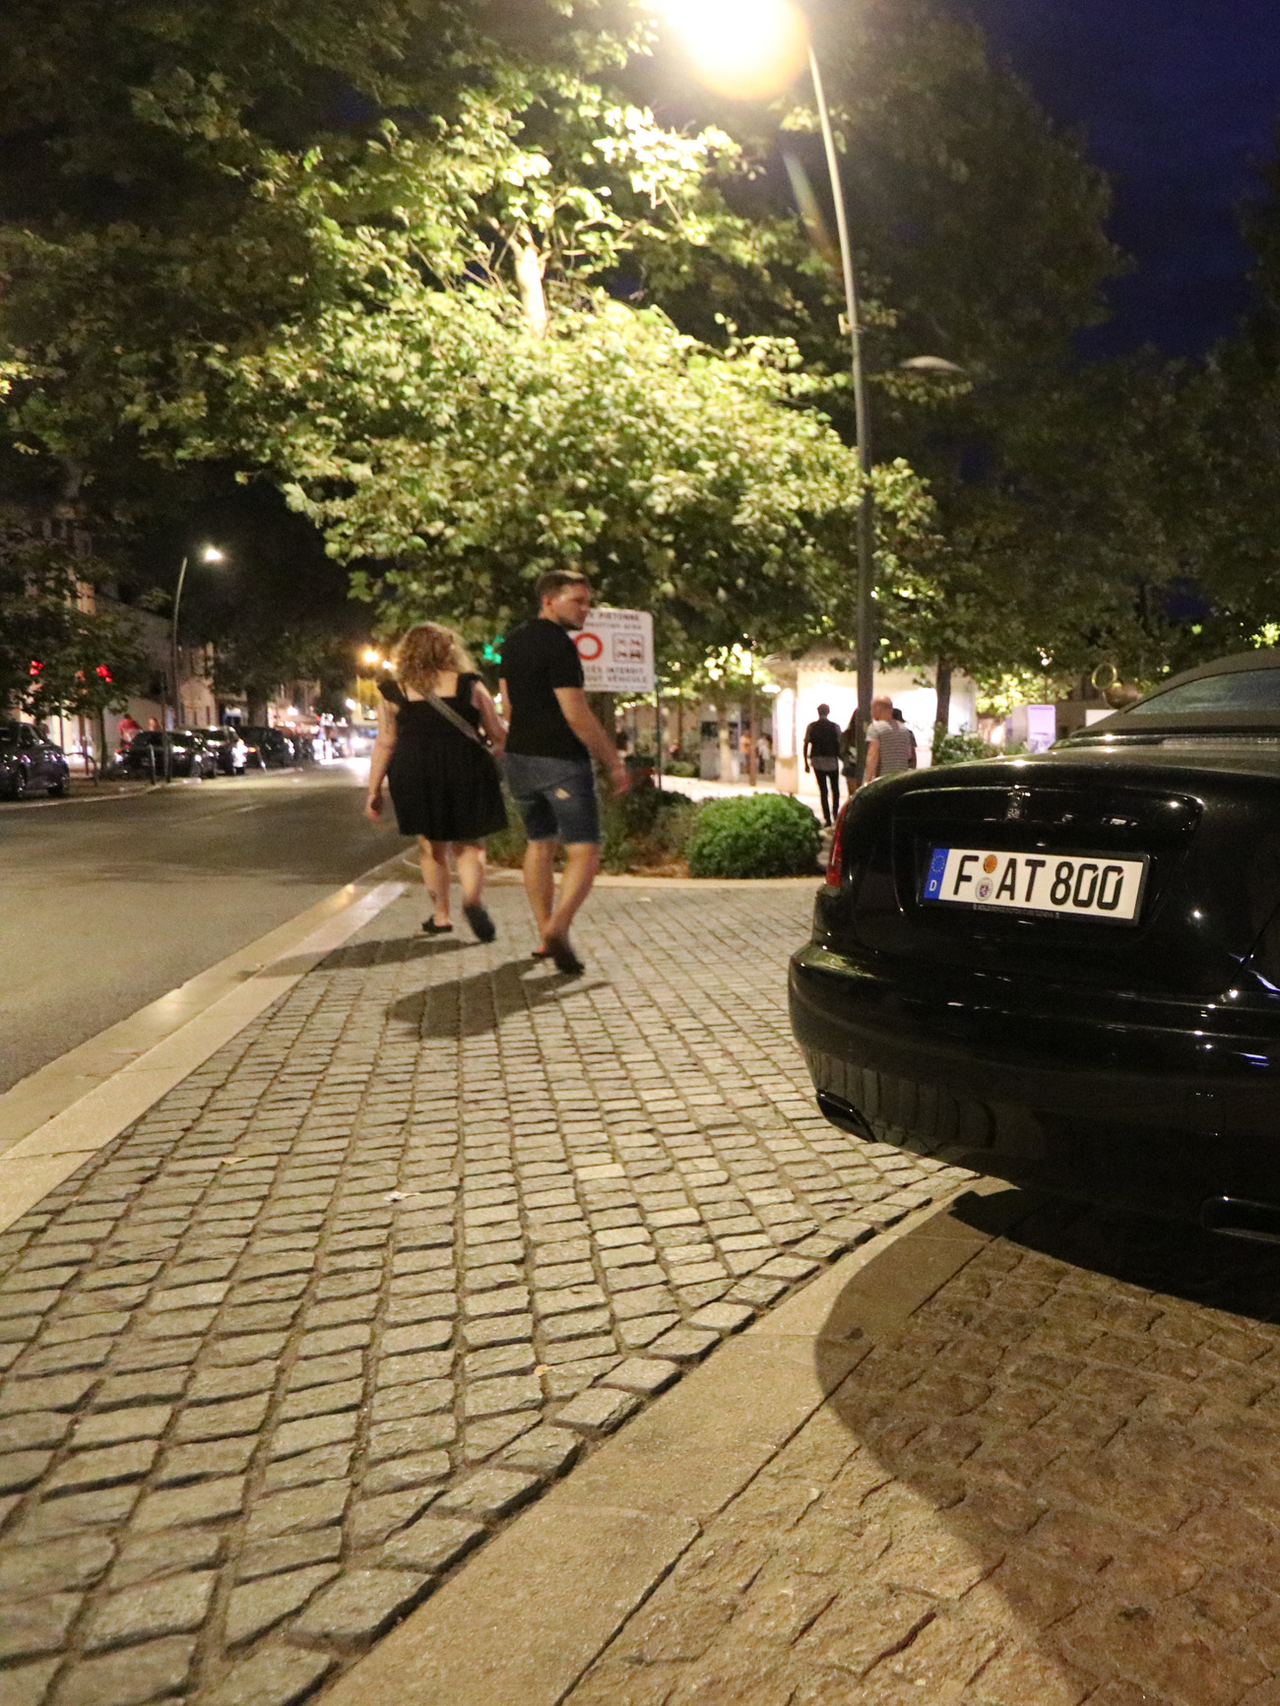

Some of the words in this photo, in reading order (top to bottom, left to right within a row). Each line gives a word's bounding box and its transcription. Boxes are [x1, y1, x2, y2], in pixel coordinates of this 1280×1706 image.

[928, 880, 937, 892] D
[953, 854, 979, 895] F
[995, 857, 1046, 902] AT
[1050, 861, 1124, 911] 800
